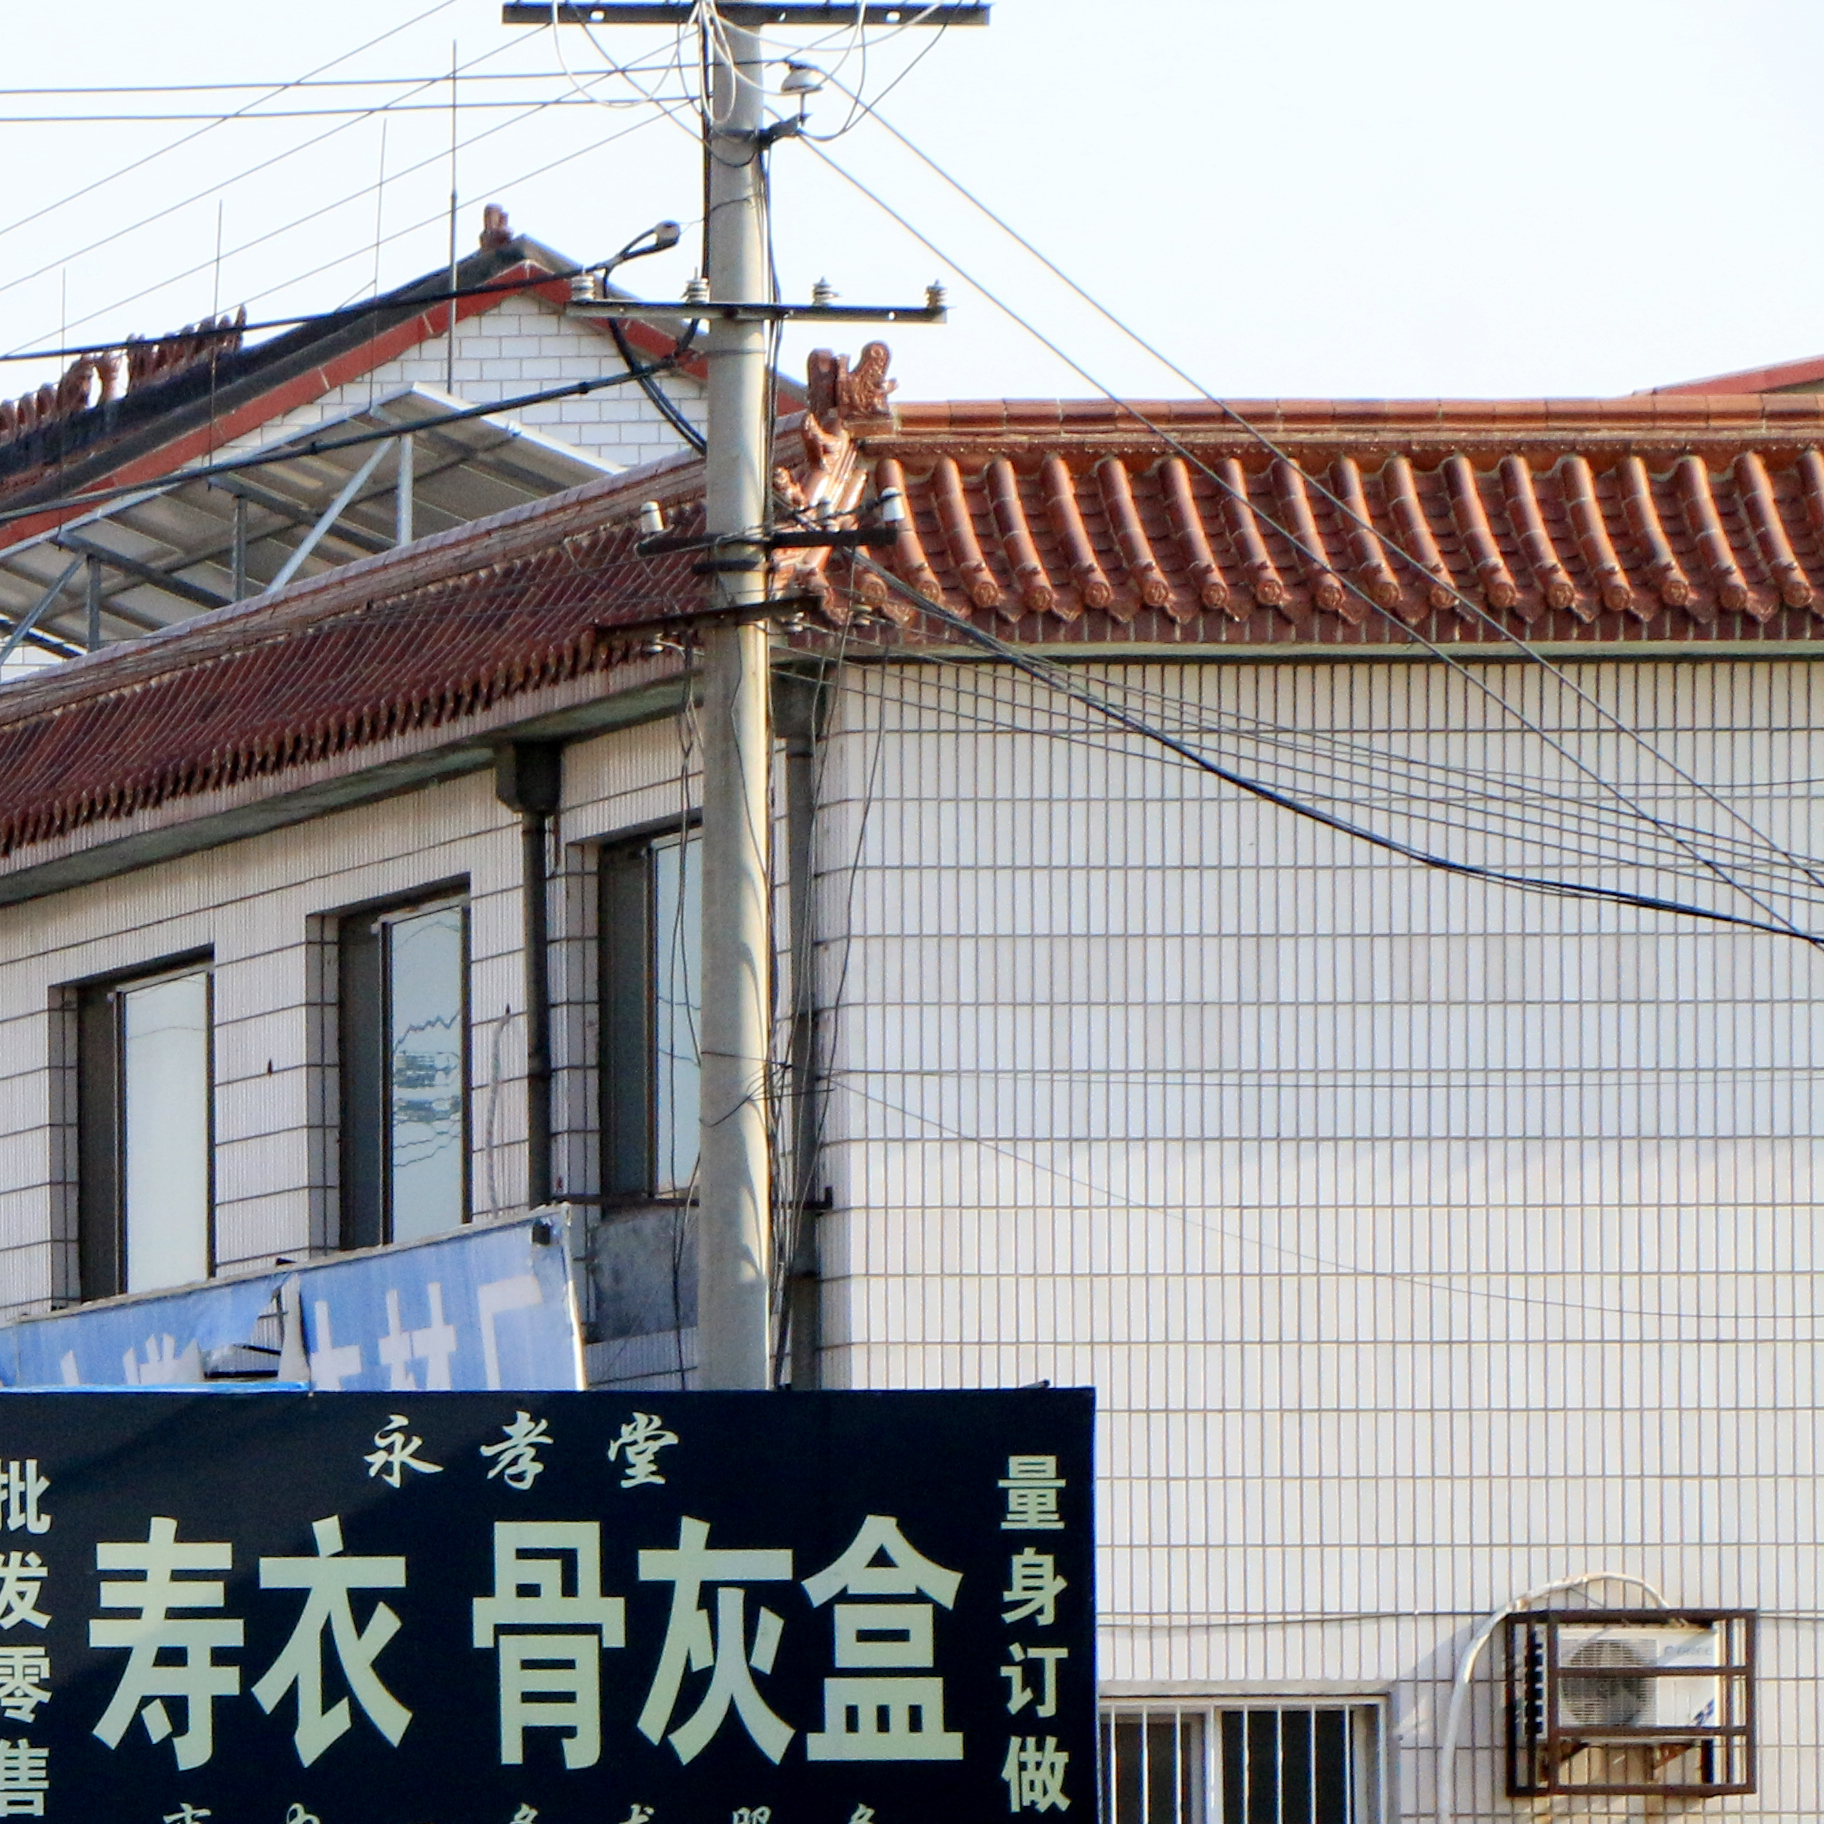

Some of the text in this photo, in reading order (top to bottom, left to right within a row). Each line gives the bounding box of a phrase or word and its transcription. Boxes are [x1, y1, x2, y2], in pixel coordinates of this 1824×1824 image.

[363, 1411, 680, 1492] 永孝堂
[88, 1514, 964, 1771] 寿衣 骨灰盒
[998, 1455, 1069, 1815] 量身订做
